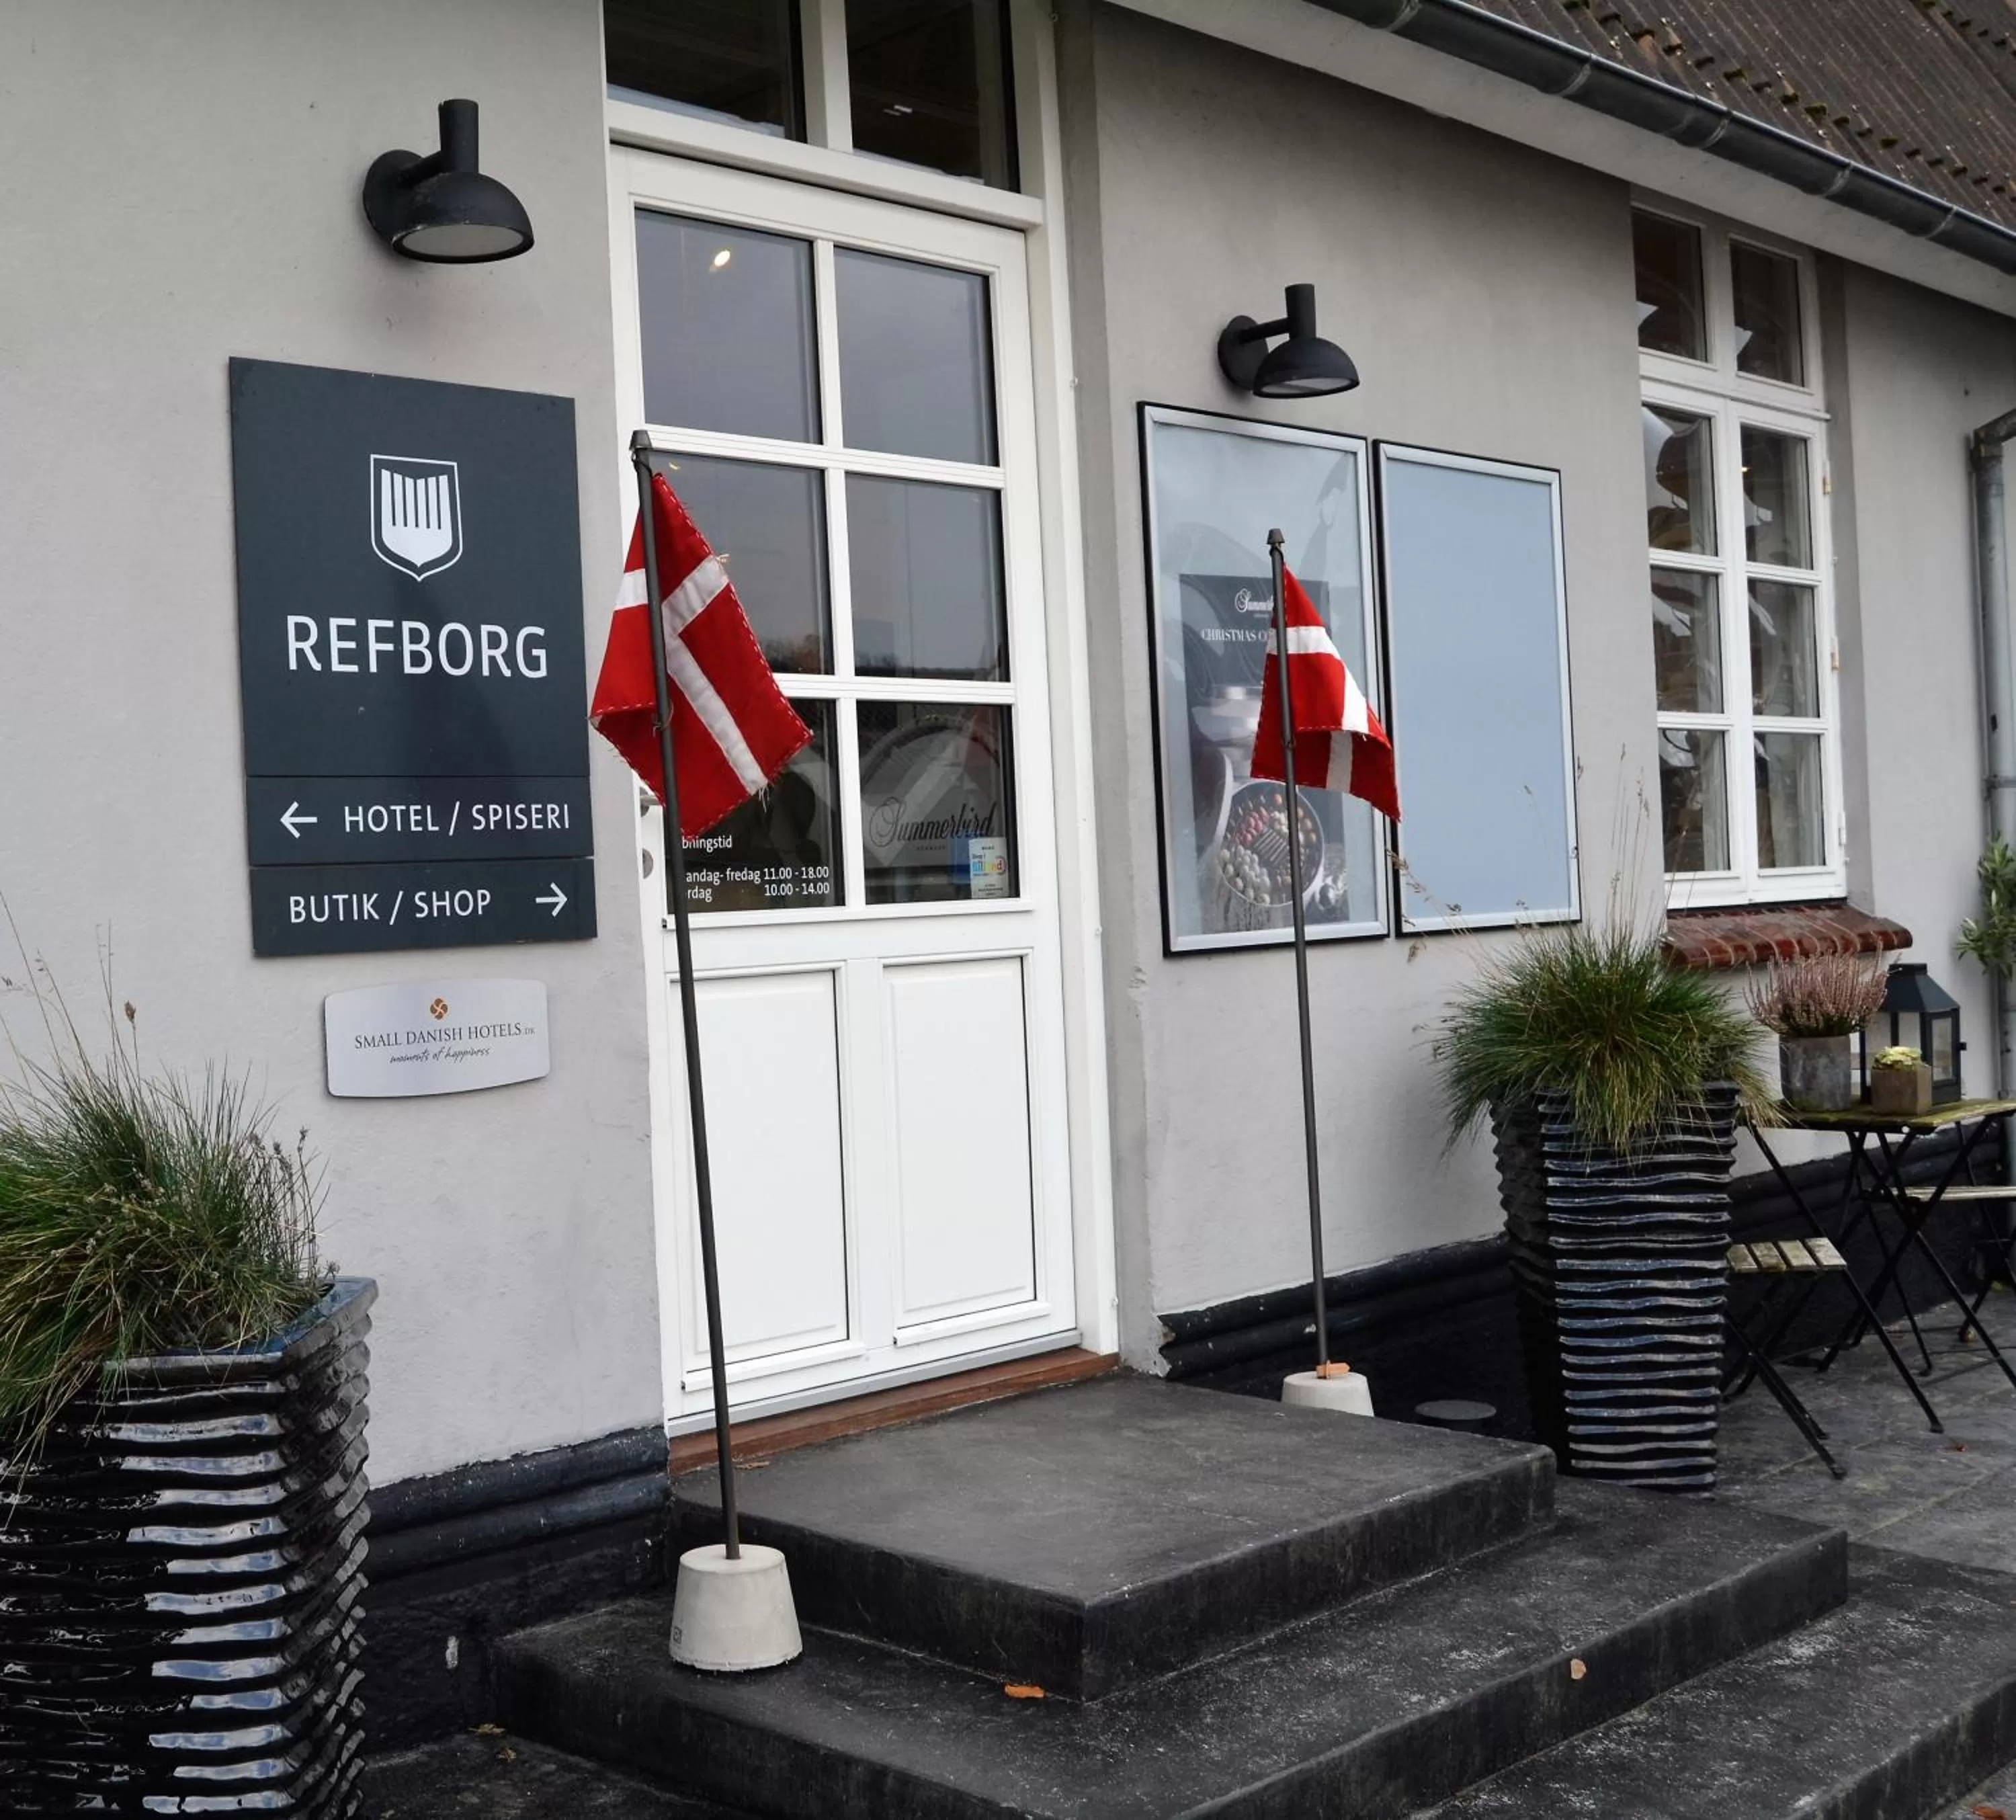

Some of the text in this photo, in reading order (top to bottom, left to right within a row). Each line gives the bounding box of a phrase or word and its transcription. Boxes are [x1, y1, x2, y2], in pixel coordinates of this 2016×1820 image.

[1201, 628, 1257, 641] CHRISTMAS
[287, 615, 548, 679] REFBORG
[344, 804, 439, 833] HOTEL
[472, 803, 569, 830] SPISERI
[869, 796, 997, 847] Summerbird
[681, 835, 732, 853] bningstid
[686, 868, 724, 886] andag-
[726, 867, 761, 884] fredag
[763, 867, 792, 880] 11.00
[801, 866, 830, 879] 18.00
[687, 885, 713, 903] rdag
[764, 883, 794, 897] 10.00
[802, 882, 831, 895] 14.00
[290, 893, 380, 923] BUTIK
[415, 889, 491, 919] SHOP
[355, 1032, 403, 1049] SMALL
[406, 1027, 462, 1045] DANISH
[432, 1046, 445, 1062] of
